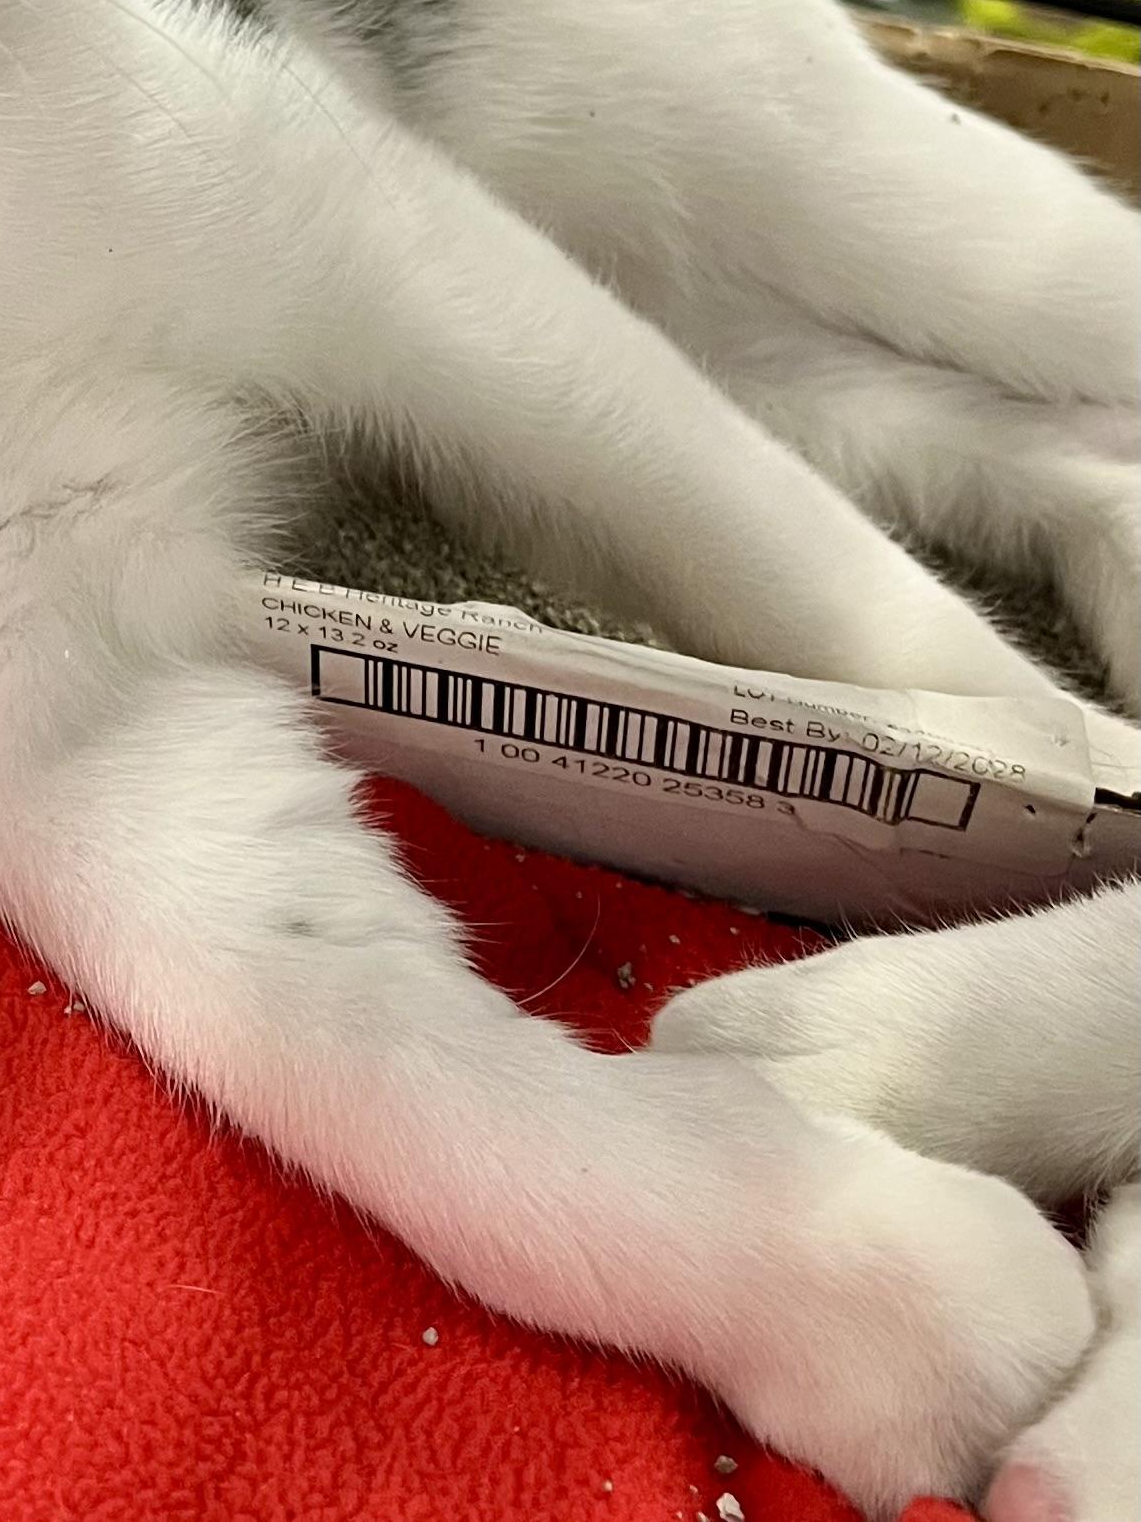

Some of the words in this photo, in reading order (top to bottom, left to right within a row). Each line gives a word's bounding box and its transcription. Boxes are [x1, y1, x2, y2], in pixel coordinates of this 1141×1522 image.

[261, 596, 372, 631] CHICKEN
[379, 618, 393, 635] &
[402, 621, 503, 656] VEGGIE
[265, 616, 290, 632] 12
[373, 639, 399, 654] oz
[474, 738, 486, 754] 1
[500, 743, 540, 764] 00
[551, 756, 652, 787] 41220
[662, 778, 766, 810] 25358
[776, 800, 796, 816] 3
[730, 708, 796, 735] Best
[862, 732, 1027, 784] 02/12/2028
